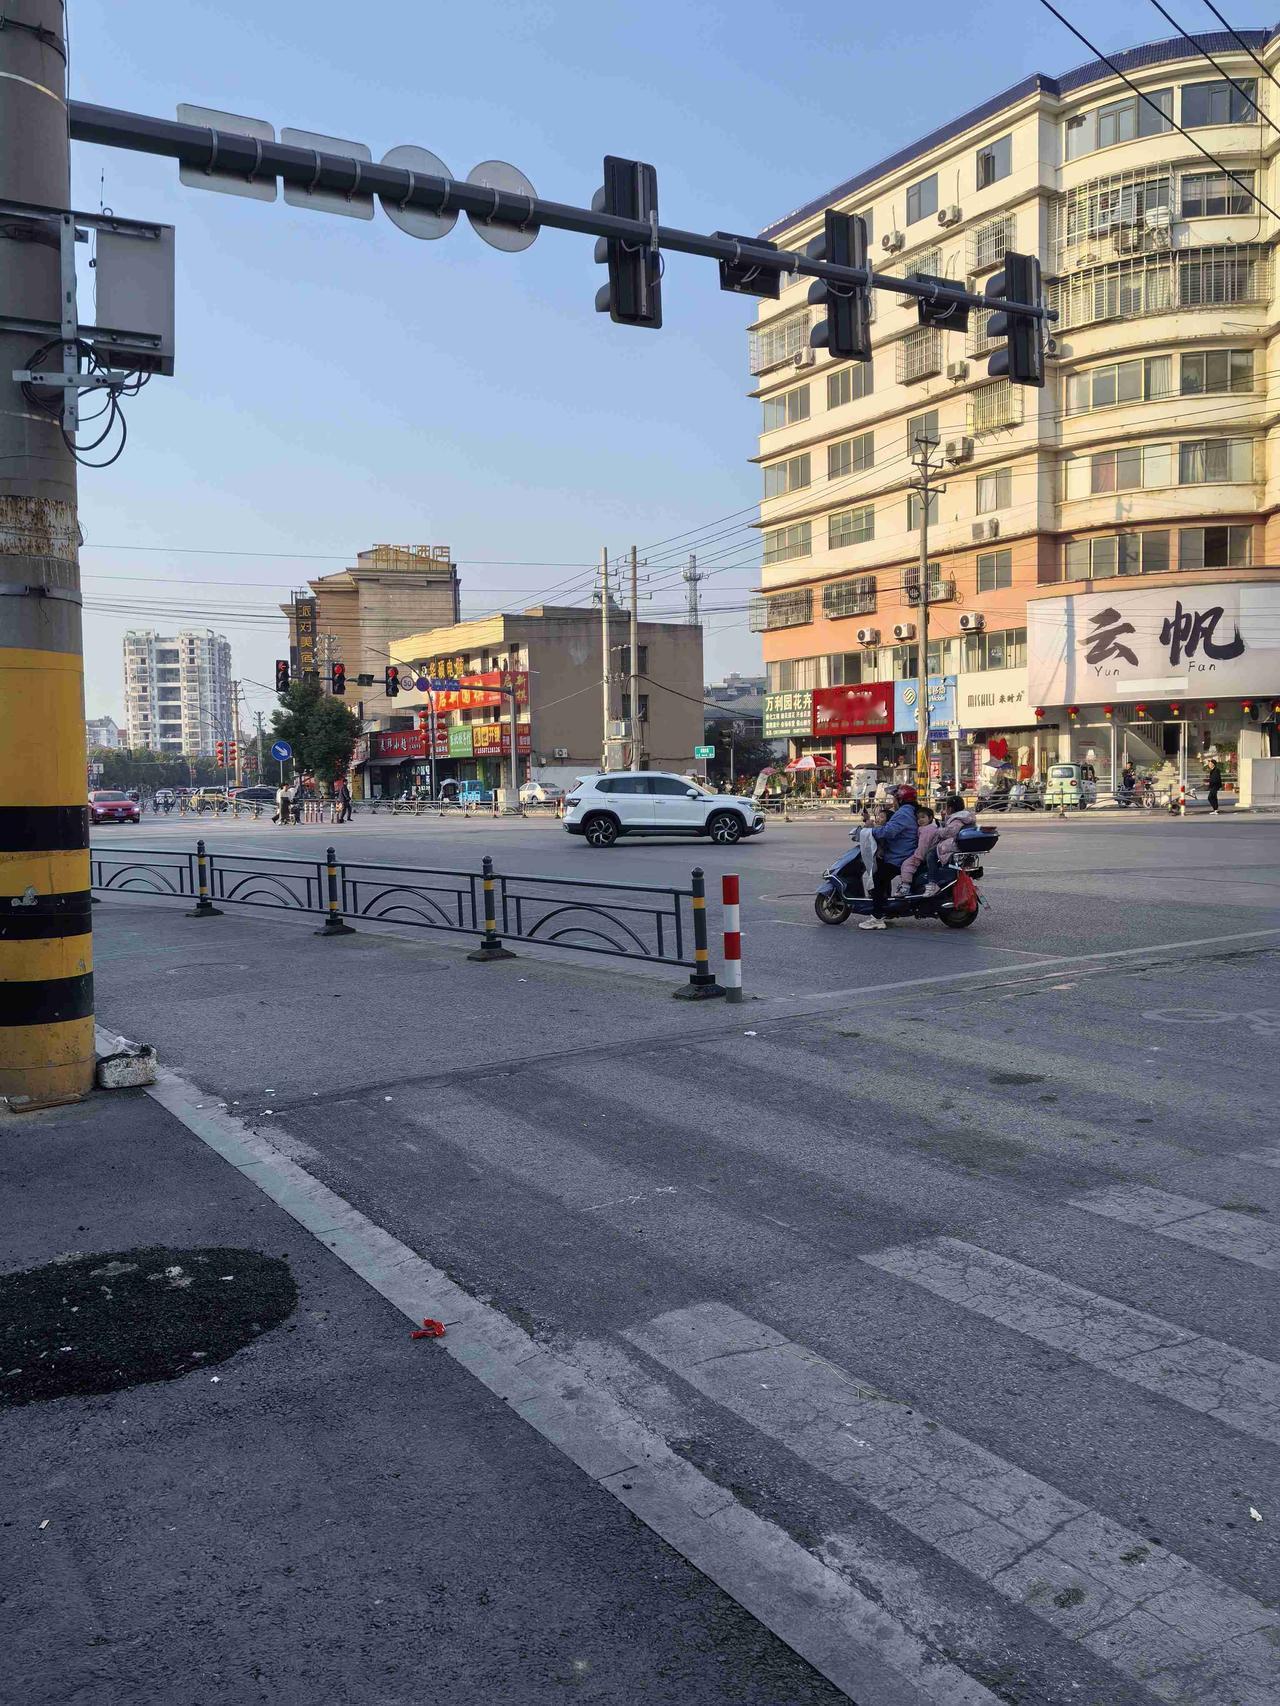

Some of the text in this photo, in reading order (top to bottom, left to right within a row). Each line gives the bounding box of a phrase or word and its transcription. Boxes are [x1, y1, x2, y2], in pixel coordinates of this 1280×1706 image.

[1077, 600, 1245, 666] 云帆
[1094, 661, 1216, 677] Yun Fan
[403, 679, 412, 688] 50
[765, 693, 812, 712] 万利园花卉
